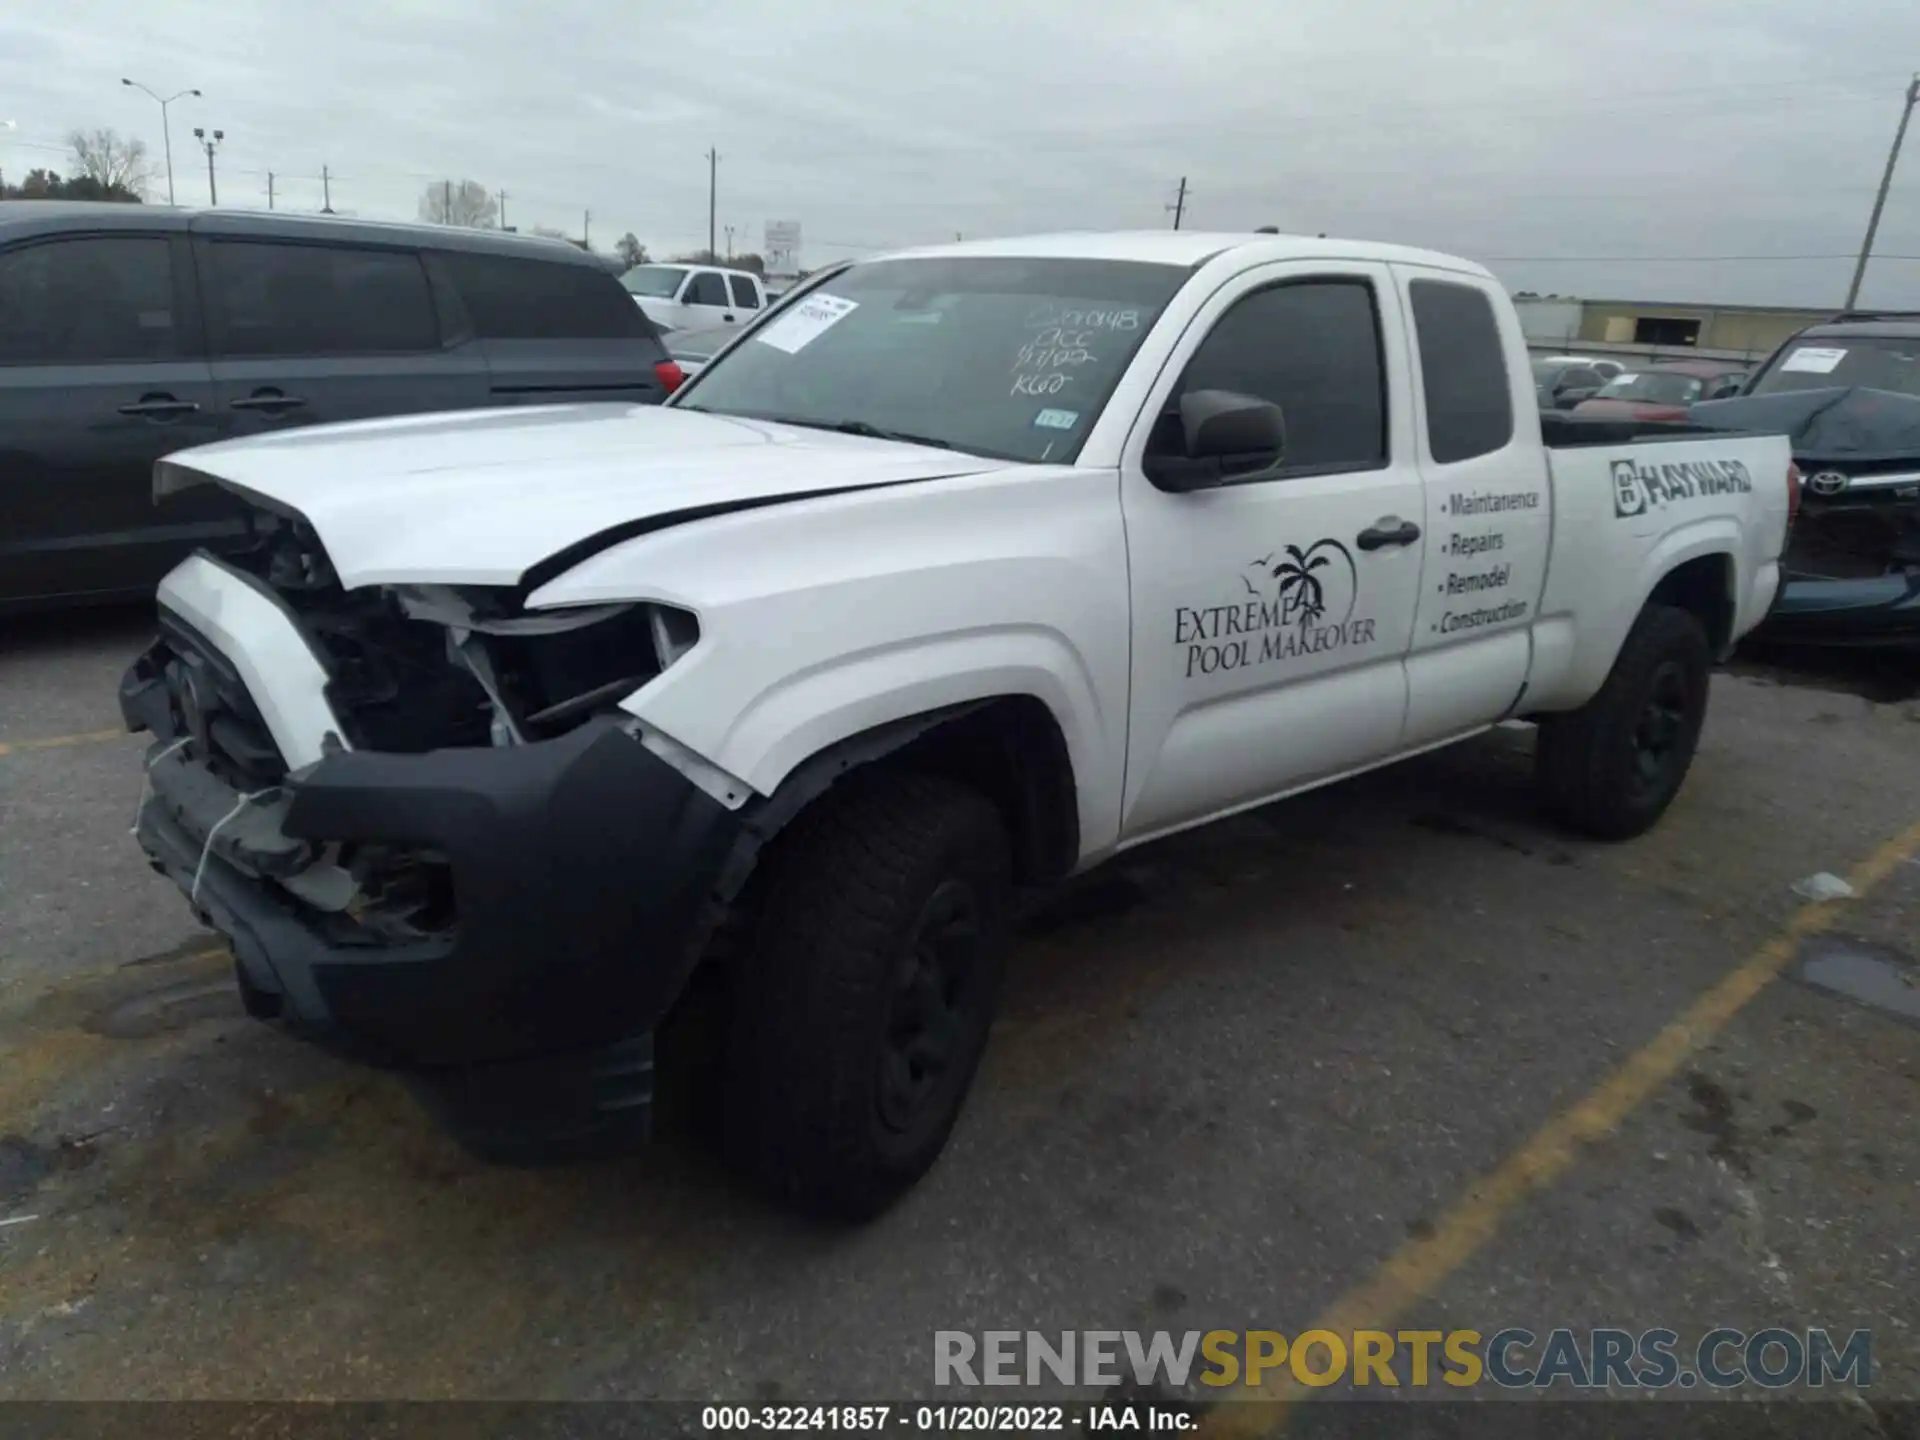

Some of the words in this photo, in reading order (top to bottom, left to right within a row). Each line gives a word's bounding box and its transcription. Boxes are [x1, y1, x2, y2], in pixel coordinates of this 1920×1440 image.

[1639, 460, 1752, 505] HAYWARD
[1450, 527, 1505, 559] Repairs
[1447, 562, 1511, 596] Remodel
[1174, 597, 1297, 645] EXTREME
[1440, 599, 1528, 634] Construction
[1186, 638, 1252, 678] POOL
[1258, 618, 1377, 665] MAKEOVER
